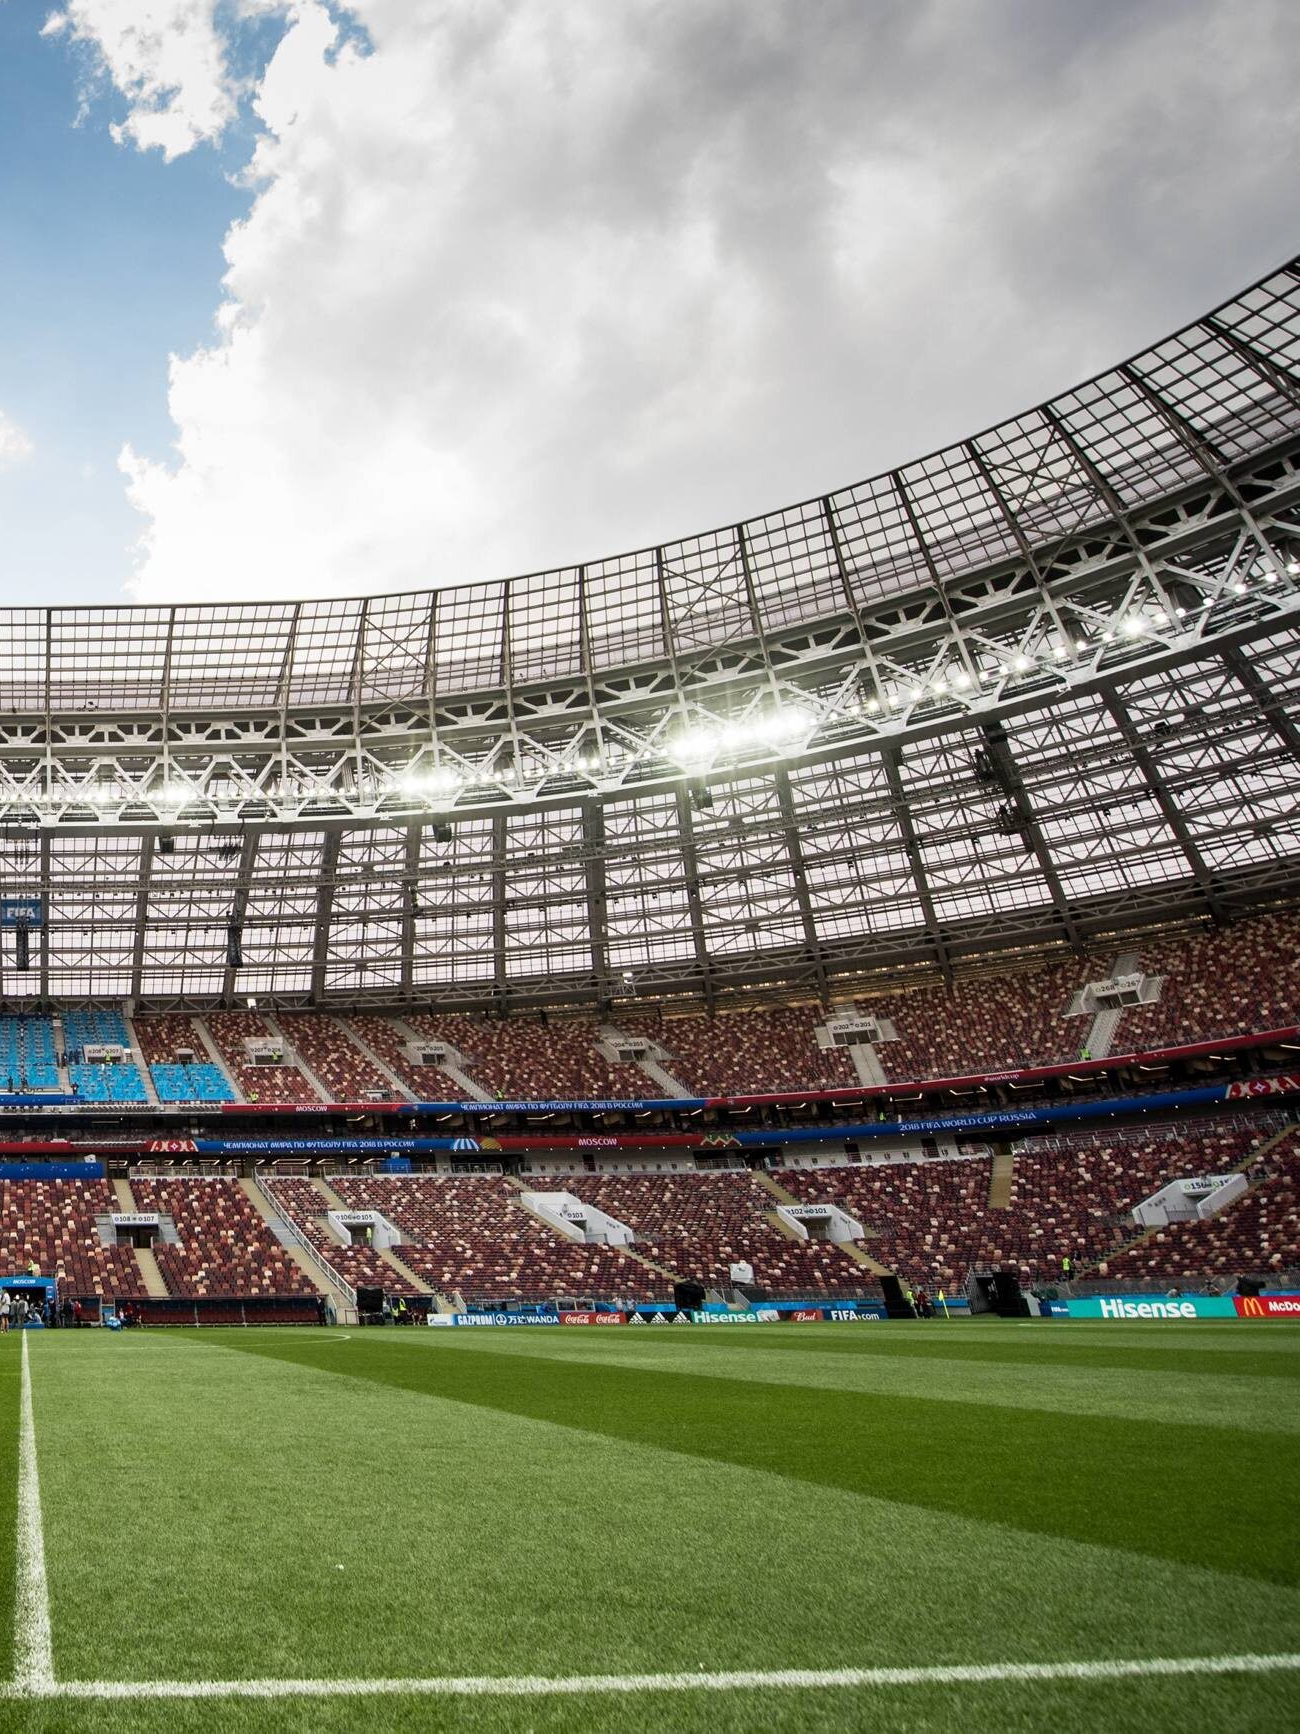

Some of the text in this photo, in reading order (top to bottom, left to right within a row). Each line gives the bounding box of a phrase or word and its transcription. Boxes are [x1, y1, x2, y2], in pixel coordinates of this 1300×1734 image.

[6, 907, 35, 918] FIFA
[921, 1121, 940, 1129] FIFA
[941, 1118, 975, 1128] WORLD
[999, 1112, 1036, 1122] RUSSIA
[578, 1138, 617, 1146] MOSCOW
[1099, 1298, 1197, 1319] Hisense
[457, 1314, 493, 1326] GAZPROM
[527, 1315, 560, 1324] WANDA
[693, 1311, 756, 1324] Hisense
[794, 1311, 817, 1321] Bud
